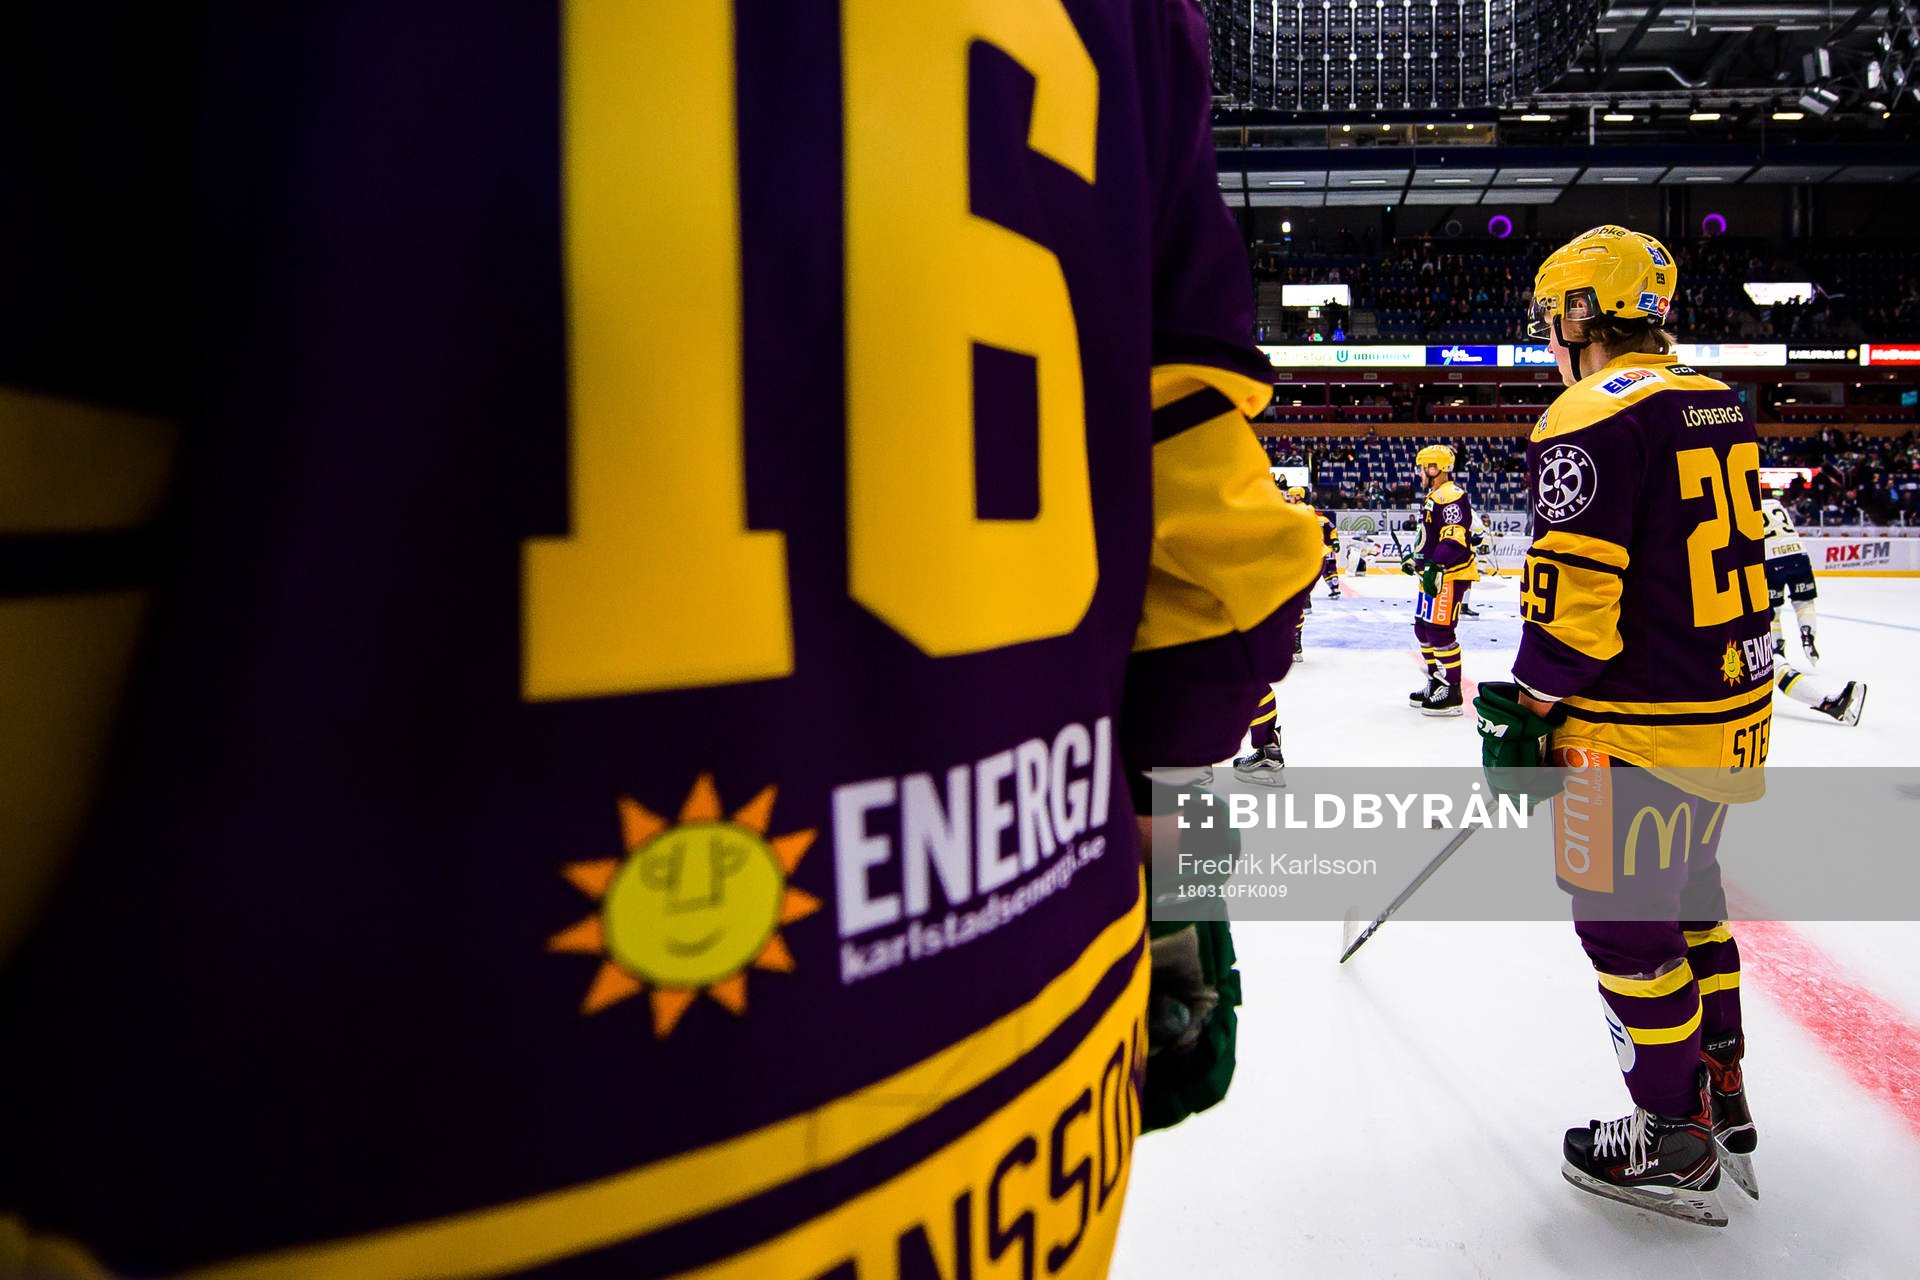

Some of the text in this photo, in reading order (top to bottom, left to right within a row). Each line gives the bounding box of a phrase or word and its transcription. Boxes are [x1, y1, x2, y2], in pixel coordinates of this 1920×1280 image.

[519, 0, 1099, 702] 16
[1682, 405, 1744, 428] LÖFBERGS
[1538, 447, 1589, 475] LÄKT
[1676, 442, 1771, 628] 29
[832, 716, 1112, 937] ENERGI
[839, 835, 1106, 984] karlstadsenergi.se
[1707, 1038, 1737, 1051] CCM
